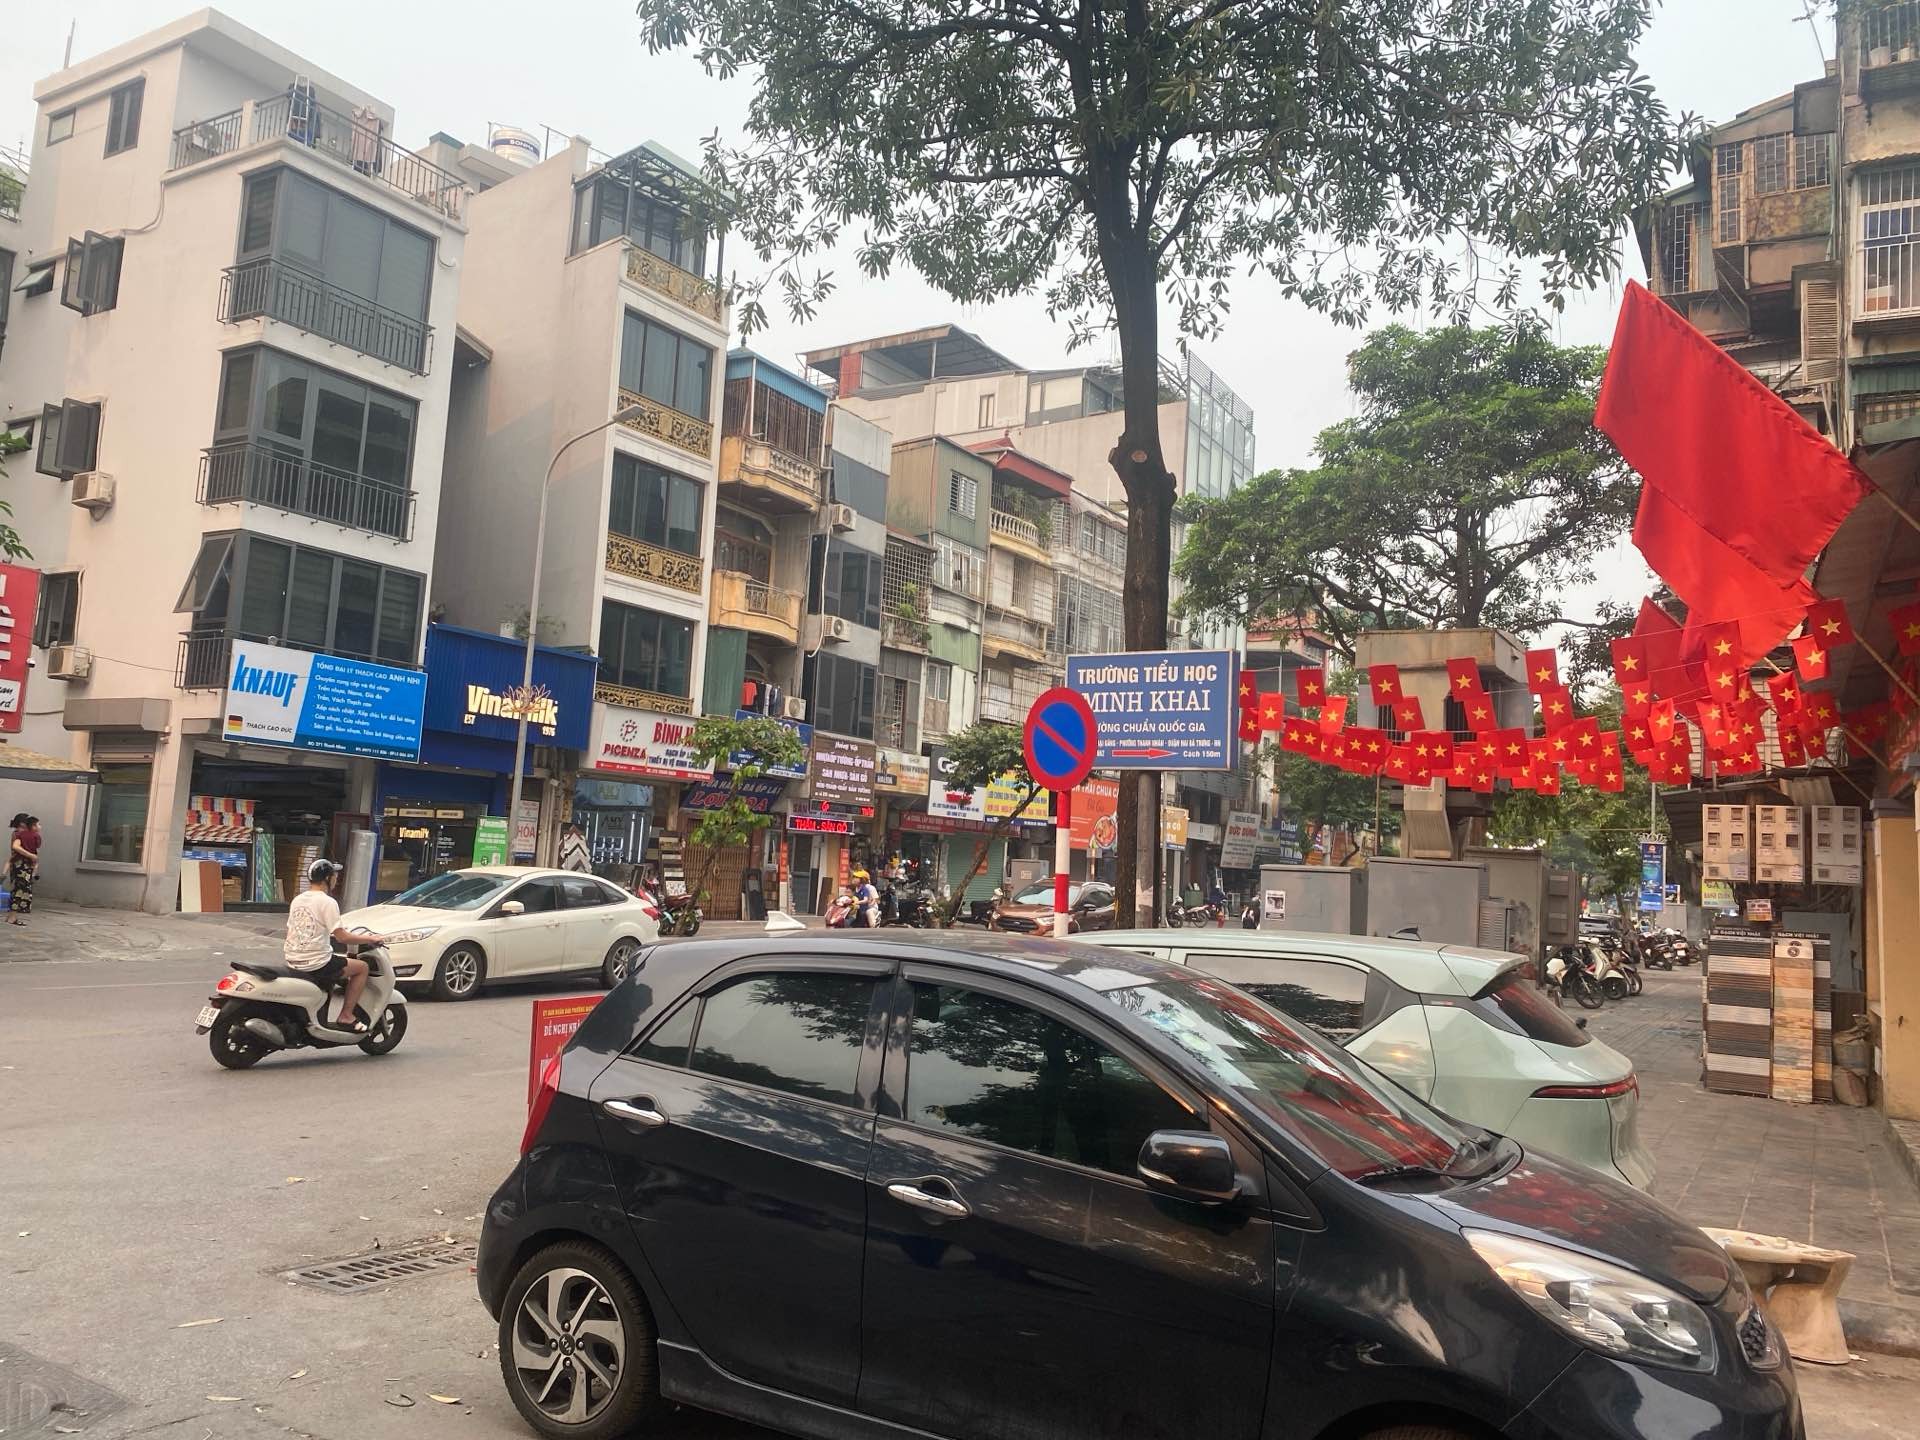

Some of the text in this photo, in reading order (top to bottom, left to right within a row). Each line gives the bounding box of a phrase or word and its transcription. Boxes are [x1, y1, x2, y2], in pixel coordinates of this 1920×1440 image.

[389, 674, 406, 682] ANH
[1078, 660, 1218, 684] TRƯỜNG TIỂU HỌC
[1081, 690, 1211, 712] MINH KHAI
[1123, 718, 1156, 732] CHUẨN
[1158, 720, 1186, 732] QUỐC
[1188, 722, 1206, 732] GIA
[602, 744, 647, 760] PICENZA
